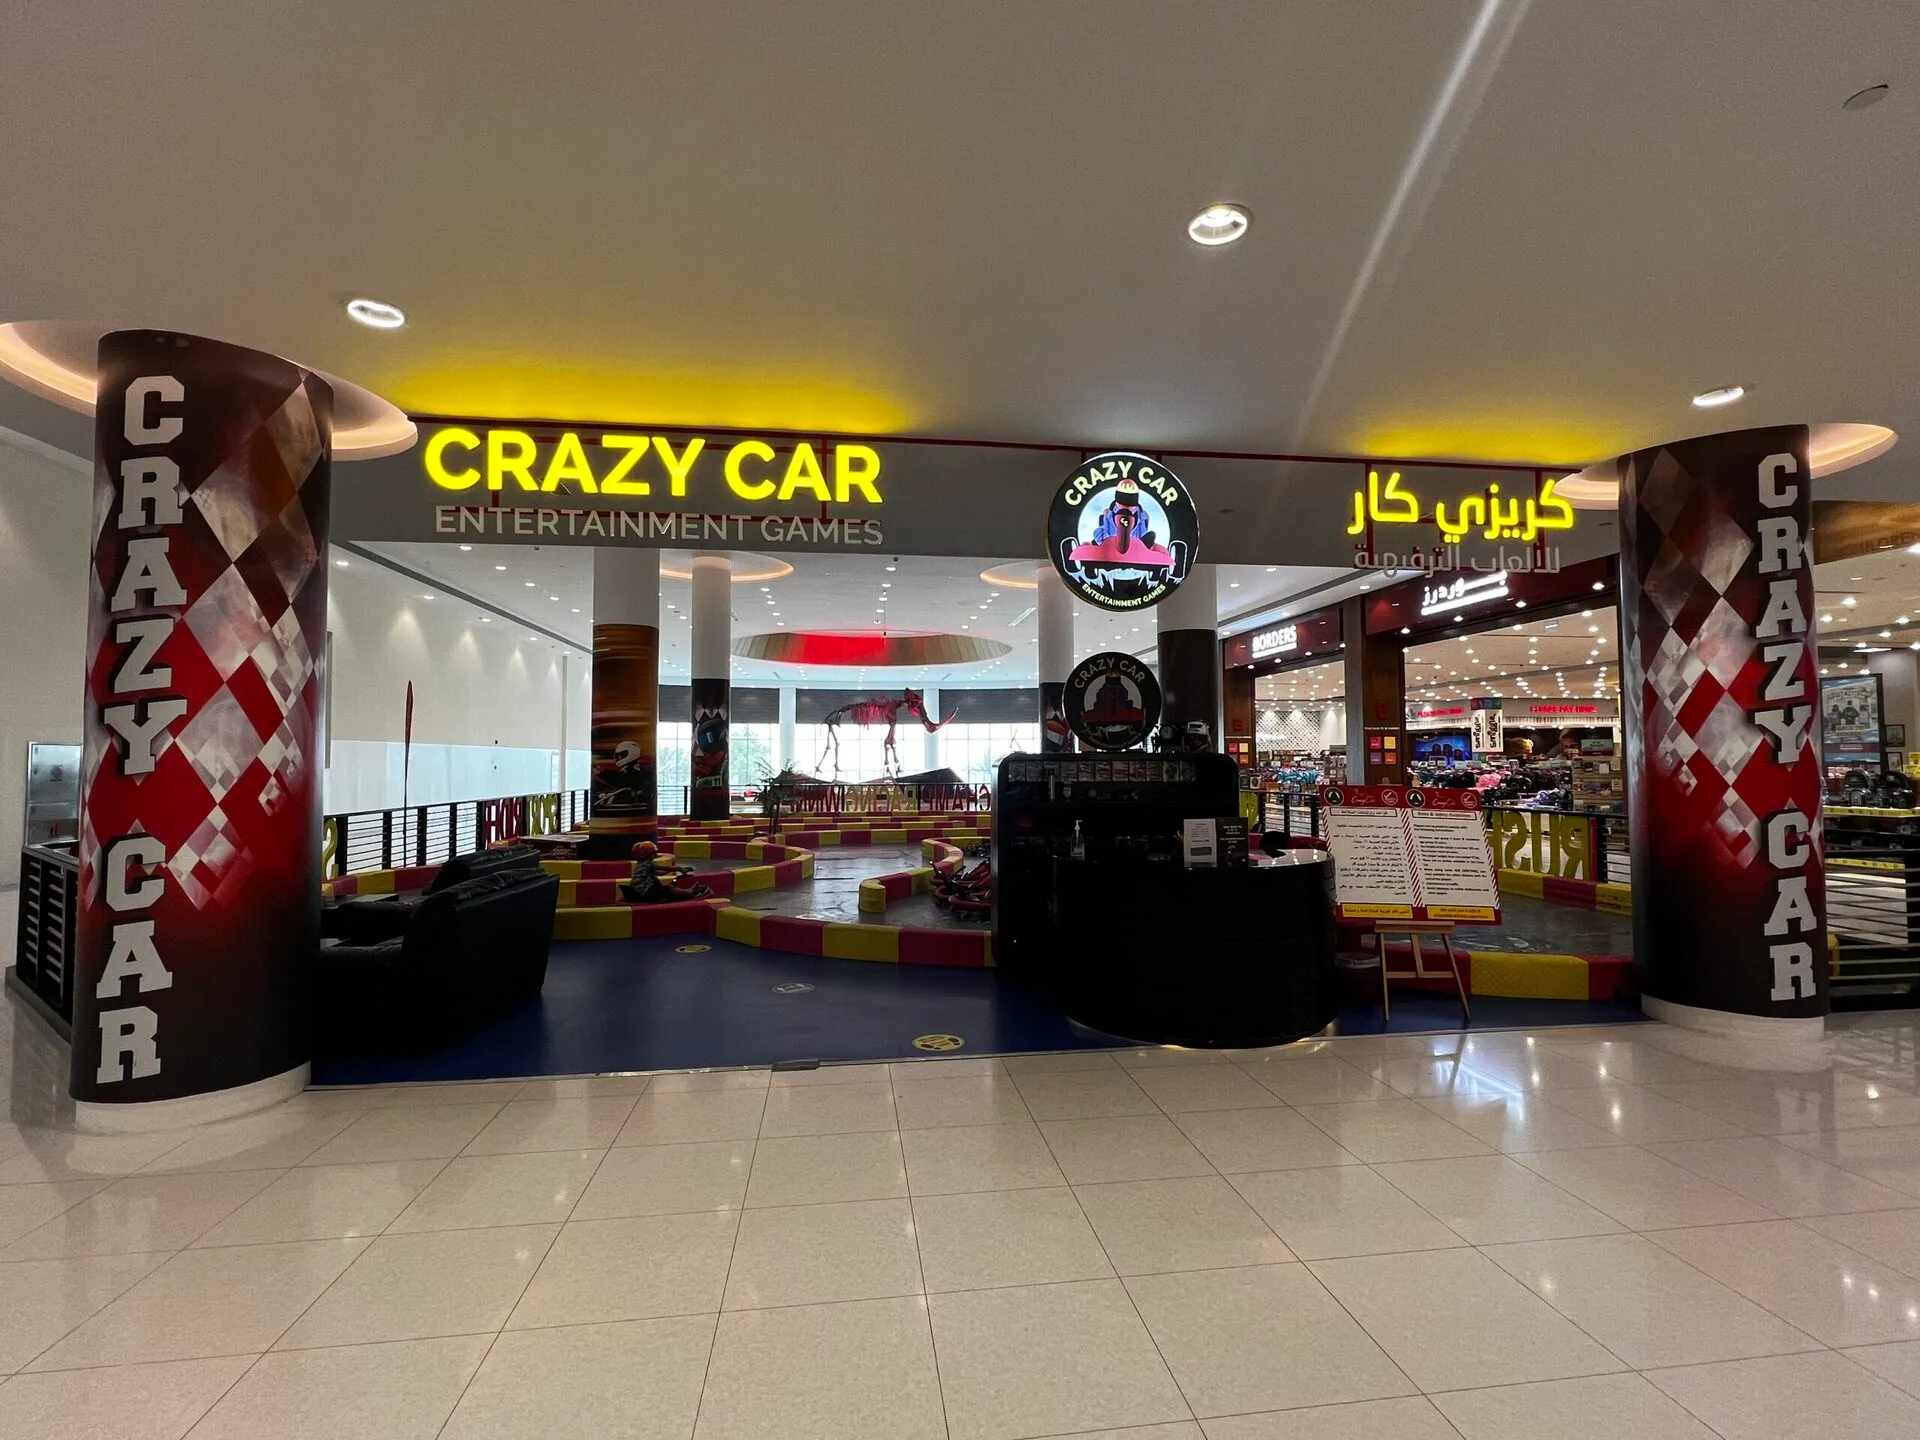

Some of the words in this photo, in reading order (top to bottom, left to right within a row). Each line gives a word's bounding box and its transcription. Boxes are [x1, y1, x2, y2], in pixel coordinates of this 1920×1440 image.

[424, 428, 706, 496] CRAZY
[725, 441, 884, 503] CAR
[1065, 461, 1133, 505] CRAZY
[1138, 467, 1178, 506] CAR
[435, 505, 752, 540] ENTERTAINMENT
[760, 514, 883, 545] GAMES
[1347, 472, 1419, 534] كار
[1436, 479, 1574, 543] كريزي
[104, 376, 187, 775] CRAZY
[1082, 583, 1142, 607] ENTERTAINMENT
[1142, 583, 1167, 602] GAMES
[1252, 625, 1297, 652] BORDERS
[1755, 453, 1812, 763] CRAZY
[1074, 657, 1115, 688] CRAZY
[1119, 660, 1146, 683] CAR
[1764, 811, 1817, 1001] CAR
[96, 836, 173, 1084] CAR
